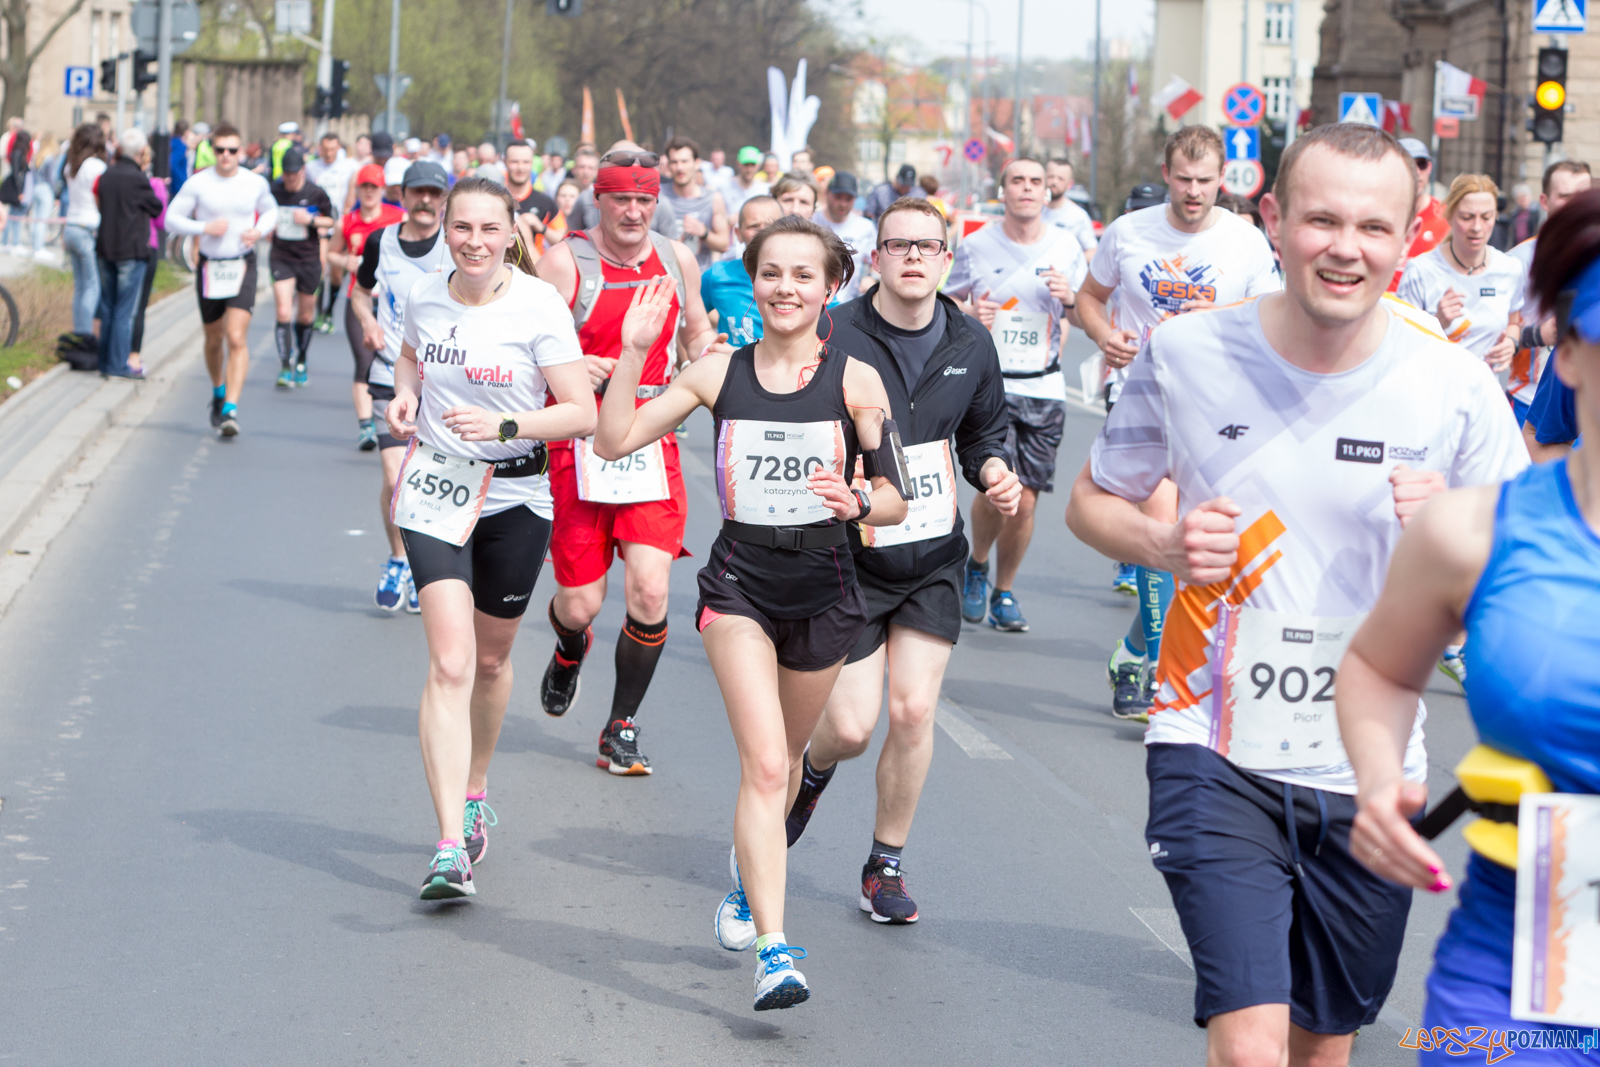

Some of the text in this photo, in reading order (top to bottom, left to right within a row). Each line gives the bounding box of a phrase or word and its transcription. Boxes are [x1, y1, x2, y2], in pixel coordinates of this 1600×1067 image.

[70, 69, 90, 93] P
[1227, 167, 1256, 187] 40
[1002, 330, 1038, 345] 1758
[424, 343, 466, 366] RUN
[1218, 424, 1249, 440] 4F
[746, 455, 824, 481] 7280
[407, 469, 470, 507] 4590
[764, 487, 807, 496] katarzyna
[419, 499, 441, 512] EMILIA
[1293, 713, 1323, 723] Piotr
